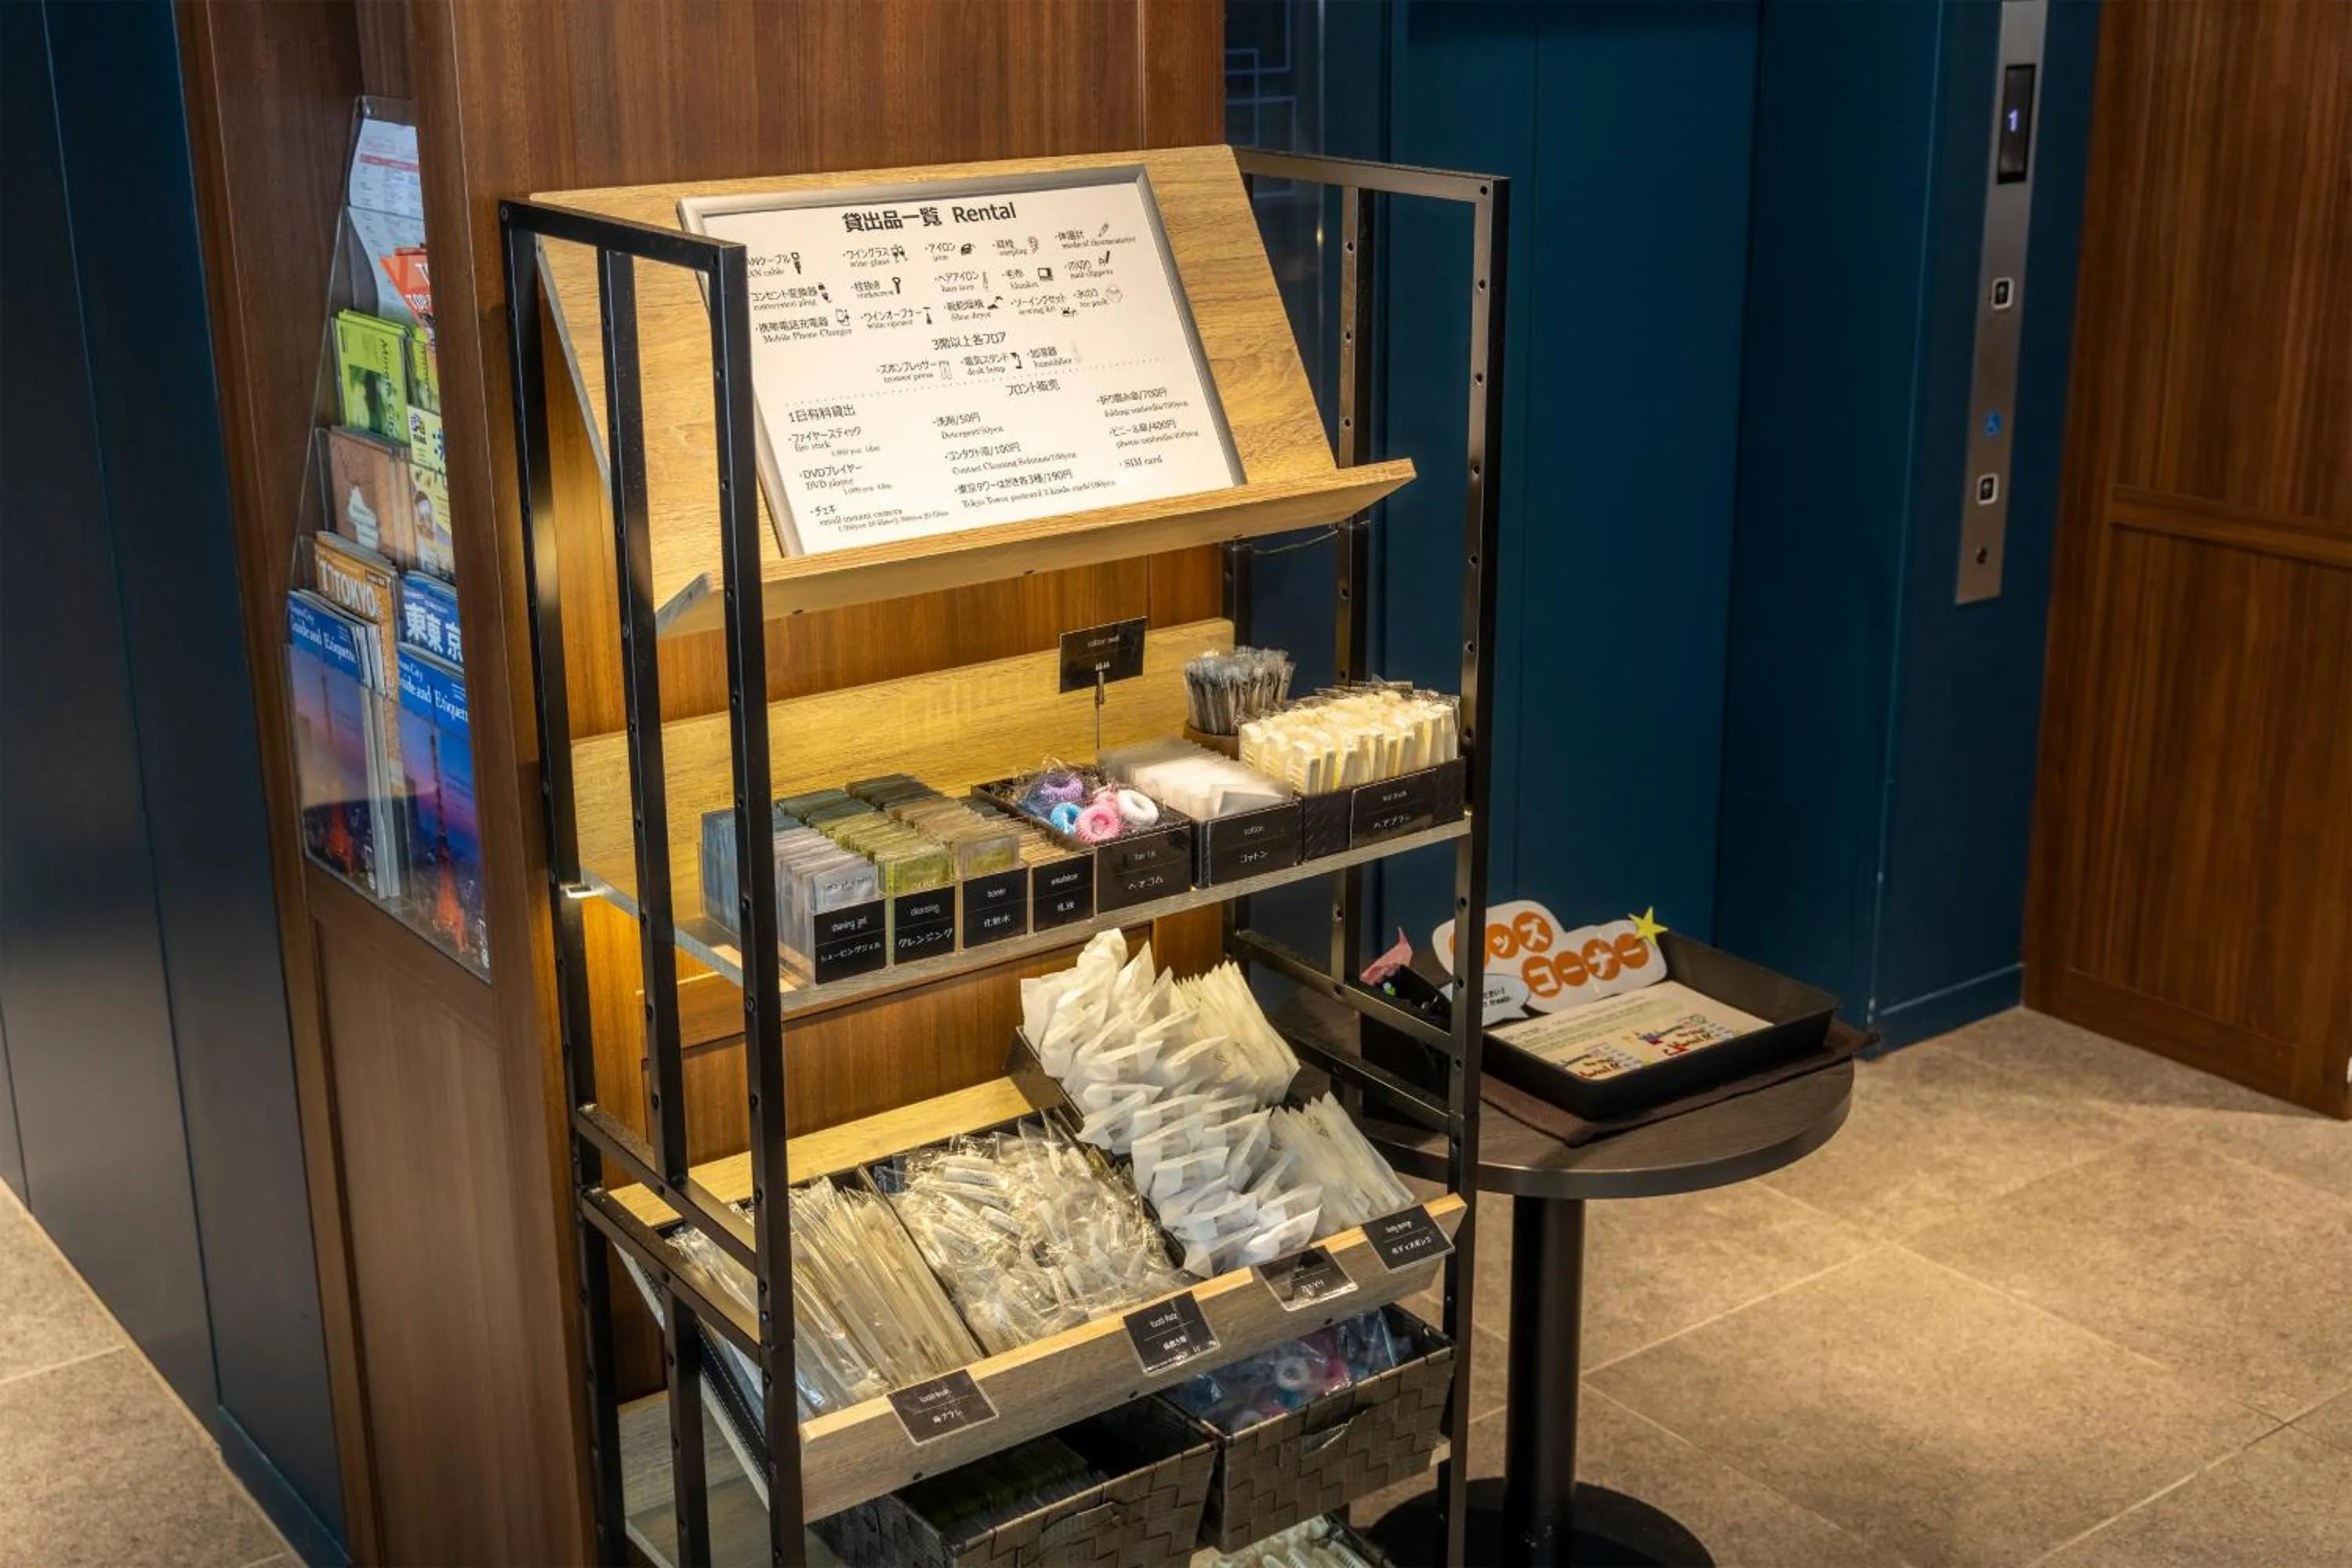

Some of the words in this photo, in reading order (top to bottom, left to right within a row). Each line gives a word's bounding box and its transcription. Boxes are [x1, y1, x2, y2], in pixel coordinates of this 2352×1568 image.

[2008, 109, 2018, 132] 1
[841, 206, 942, 233] 貸出品一覧
[952, 201, 1017, 223] Rental
[846, 246, 891, 260] ワイングラス
[928, 242, 956, 253] アイロン
[863, 308, 922, 322] ワインオープナー
[763, 333, 791, 344] Mobile
[793, 329, 818, 340] Phone
[819, 327, 853, 339] Charger
[931, 332, 1007, 350] 3階以上各フロア
[963, 352, 1007, 367] 電気スタンド
[1005, 379, 1061, 396] フロント販売
[789, 405, 856, 423] 1日有料貸出
[791, 426, 862, 442] ファイヤースティック
[1123, 457, 1142, 468] SIM
[1144, 455, 1163, 465] card
[803, 464, 863, 480] DVDプレイヤー
[805, 481, 828, 491] DVD
[961, 498, 985, 509] Tokyo
[986, 495, 1009, 505] Tower
[815, 504, 837, 517] チェキ
[1492, 916, 1550, 953] ッズ
[1528, 947, 1642, 993] コーナー
